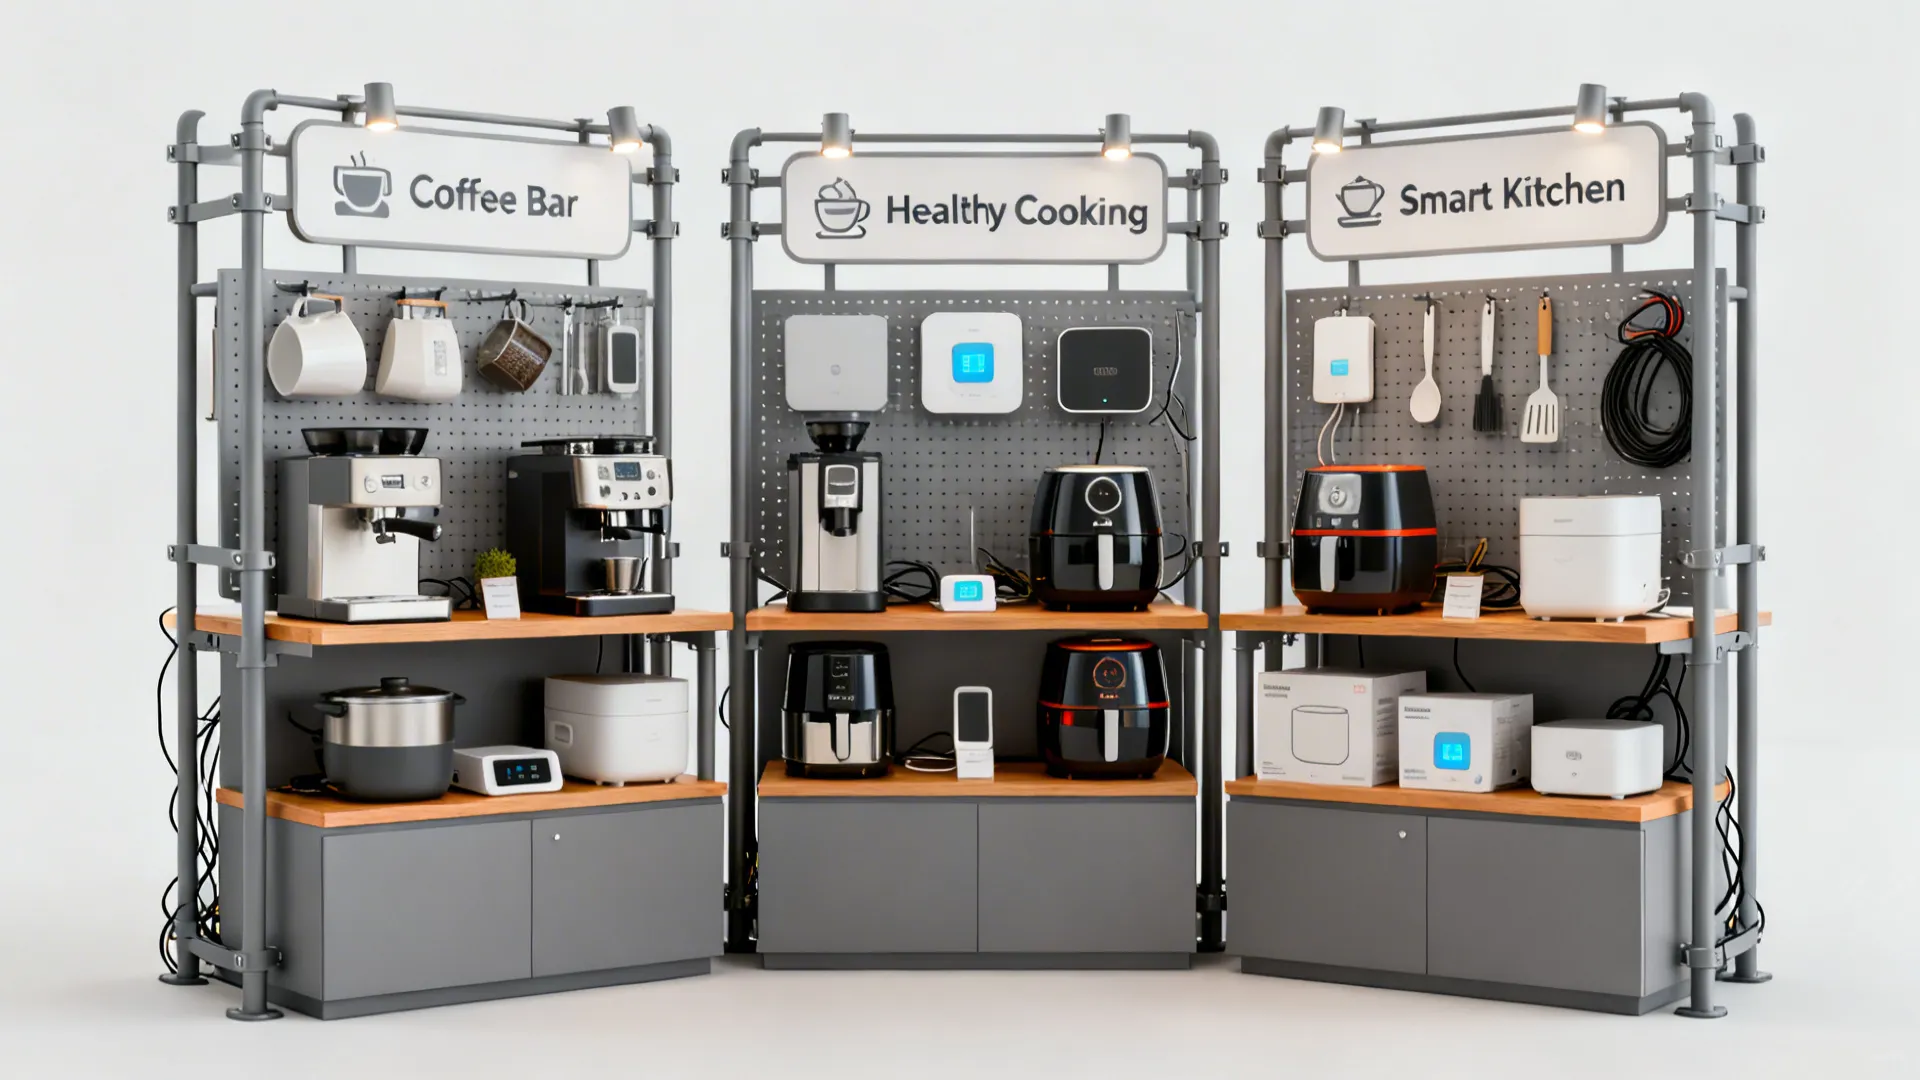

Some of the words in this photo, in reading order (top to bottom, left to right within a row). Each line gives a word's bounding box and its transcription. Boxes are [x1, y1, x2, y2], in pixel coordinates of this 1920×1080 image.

[409, 173, 517, 216] Coffee
[527, 184, 579, 218] Bar
[886, 193, 1008, 233] Healthy
[1014, 193, 1148, 235] Cooking
[1399, 181, 1494, 217] Smart
[1503, 171, 1625, 211] Kitchen
